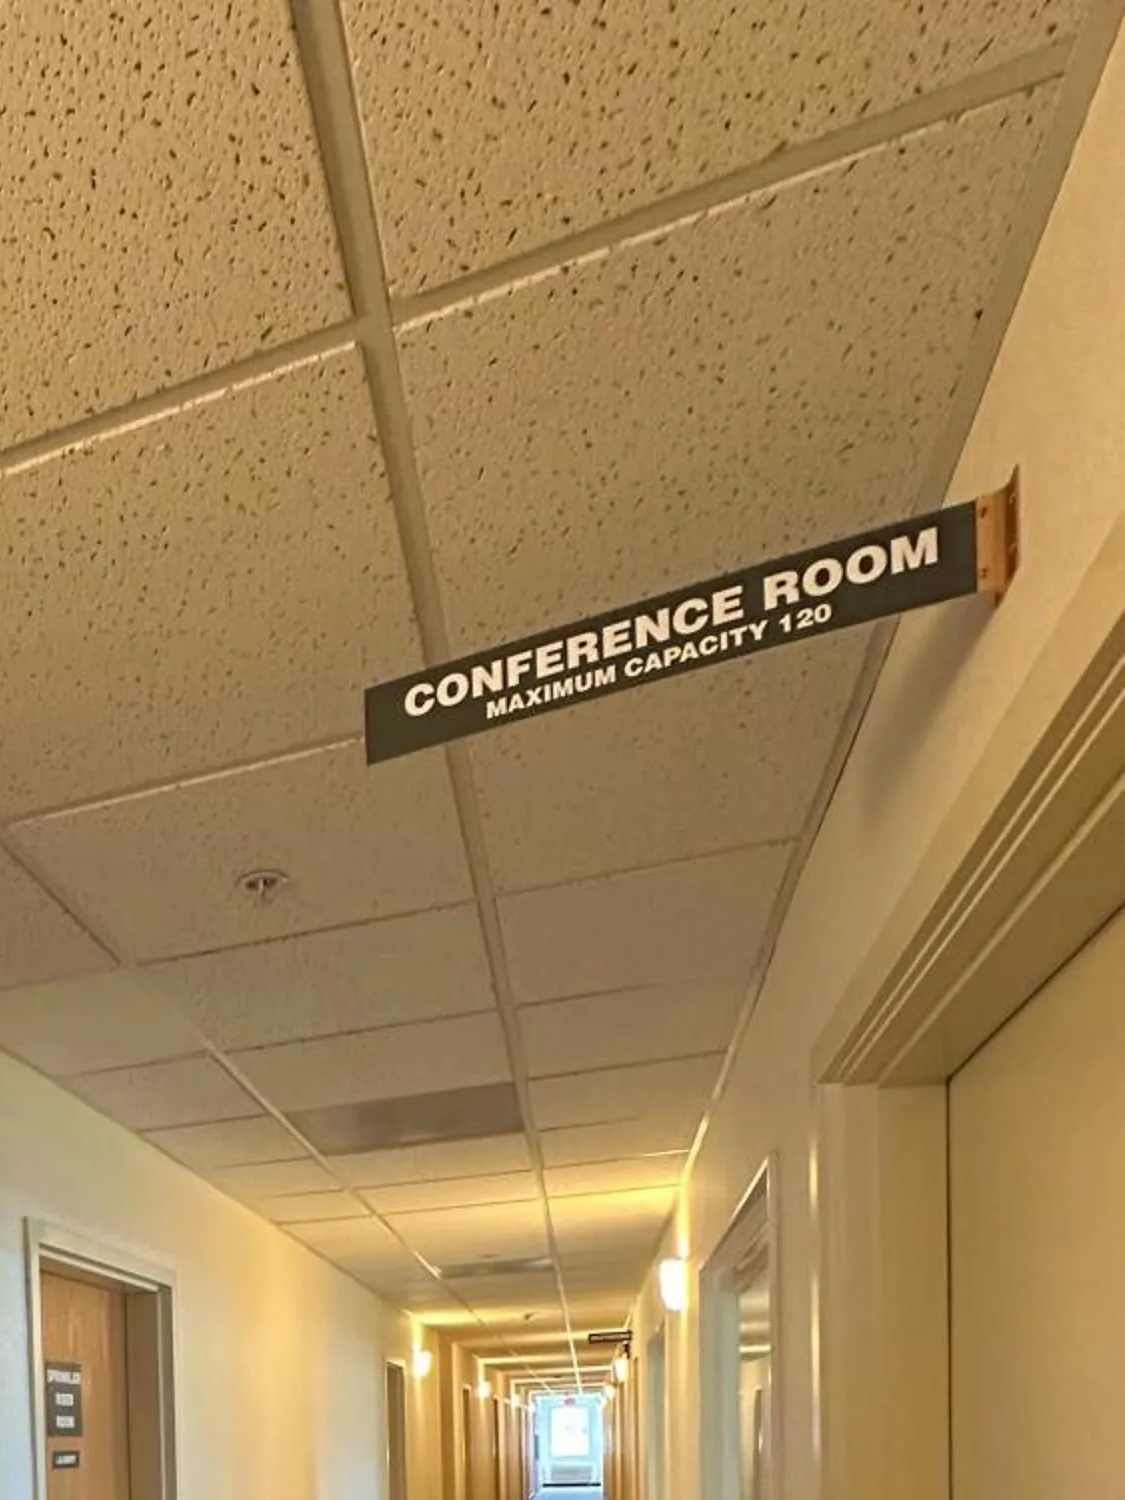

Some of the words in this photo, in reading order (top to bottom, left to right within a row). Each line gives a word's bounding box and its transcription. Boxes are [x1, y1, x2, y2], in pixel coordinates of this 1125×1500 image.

[403, 584, 745, 718] CONFERENCE
[761, 526, 939, 612] ROOM
[485, 664, 617, 721] MAXIMUM
[623, 618, 770, 678] CAPACITY
[777, 602, 832, 633] 120
